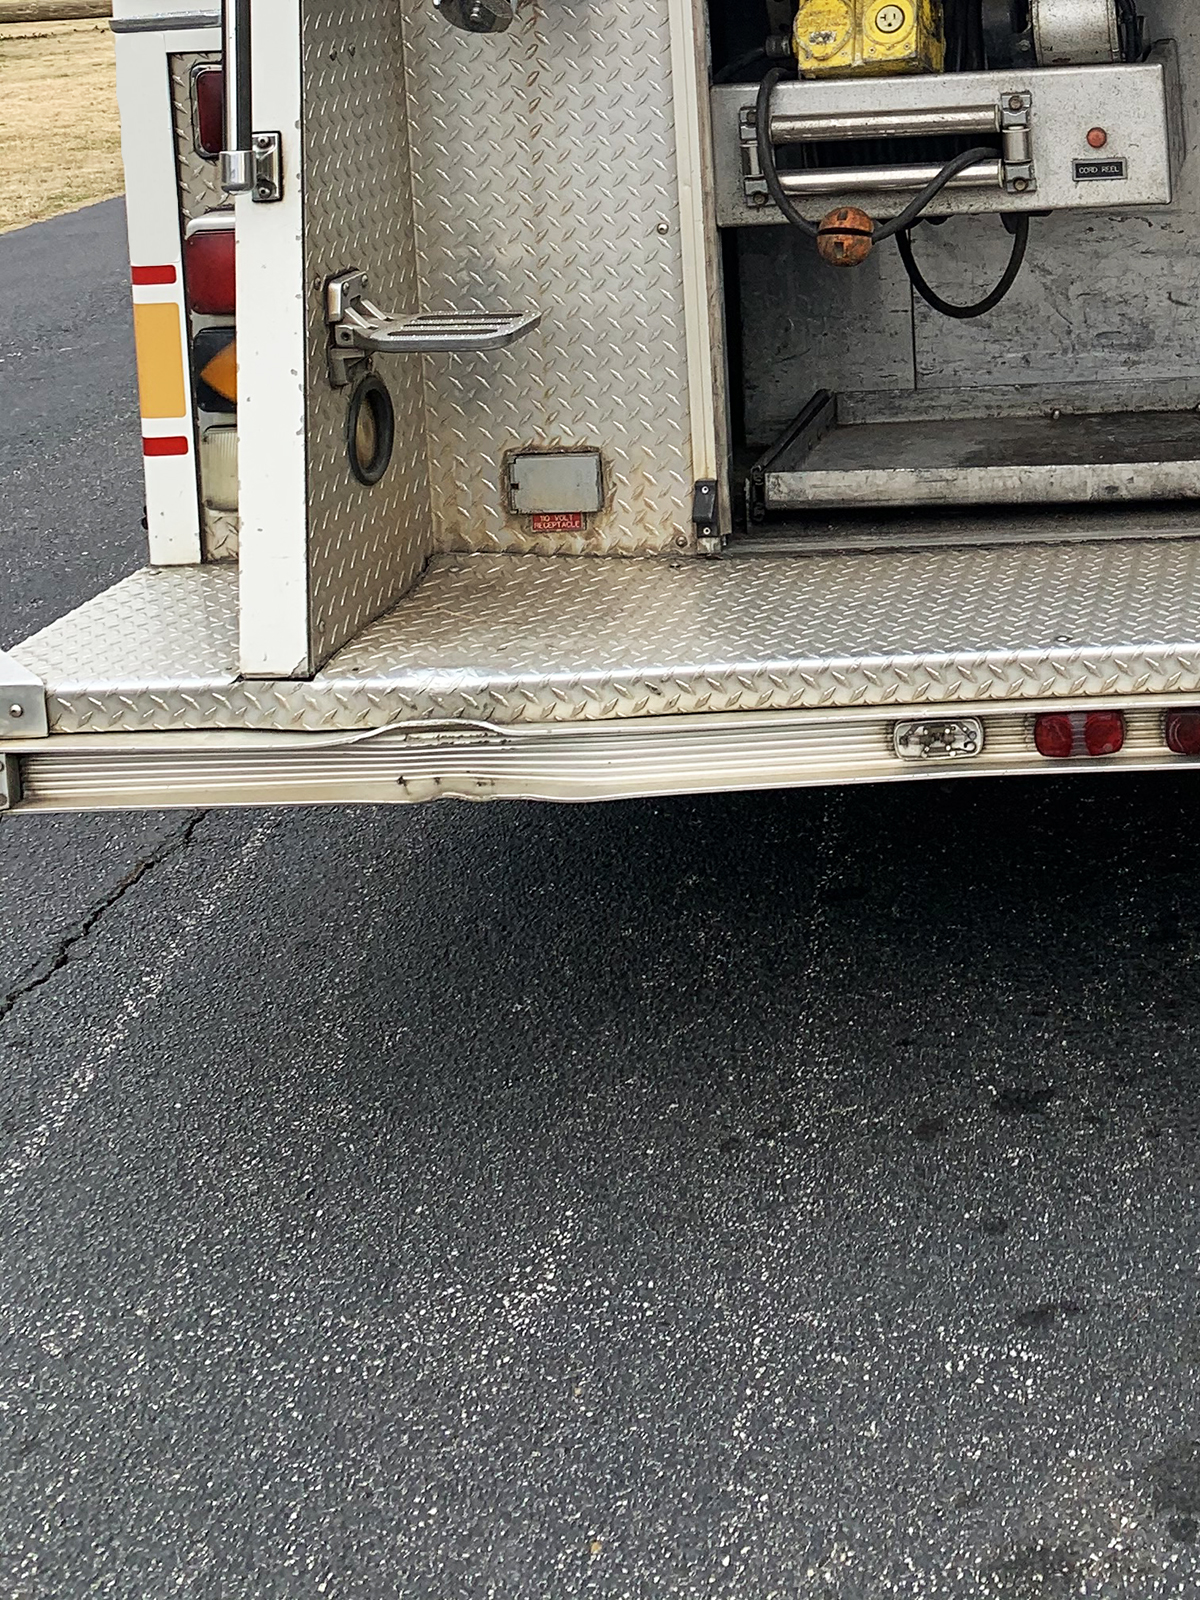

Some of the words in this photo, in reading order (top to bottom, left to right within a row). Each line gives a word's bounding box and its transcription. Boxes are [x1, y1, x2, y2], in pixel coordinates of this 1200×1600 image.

[1078, 166, 1099, 174] CORD
[1101, 165, 1120, 173] REEL
[554, 514, 574, 522] VOLT
[533, 520, 581, 529] RECEPTACLE
